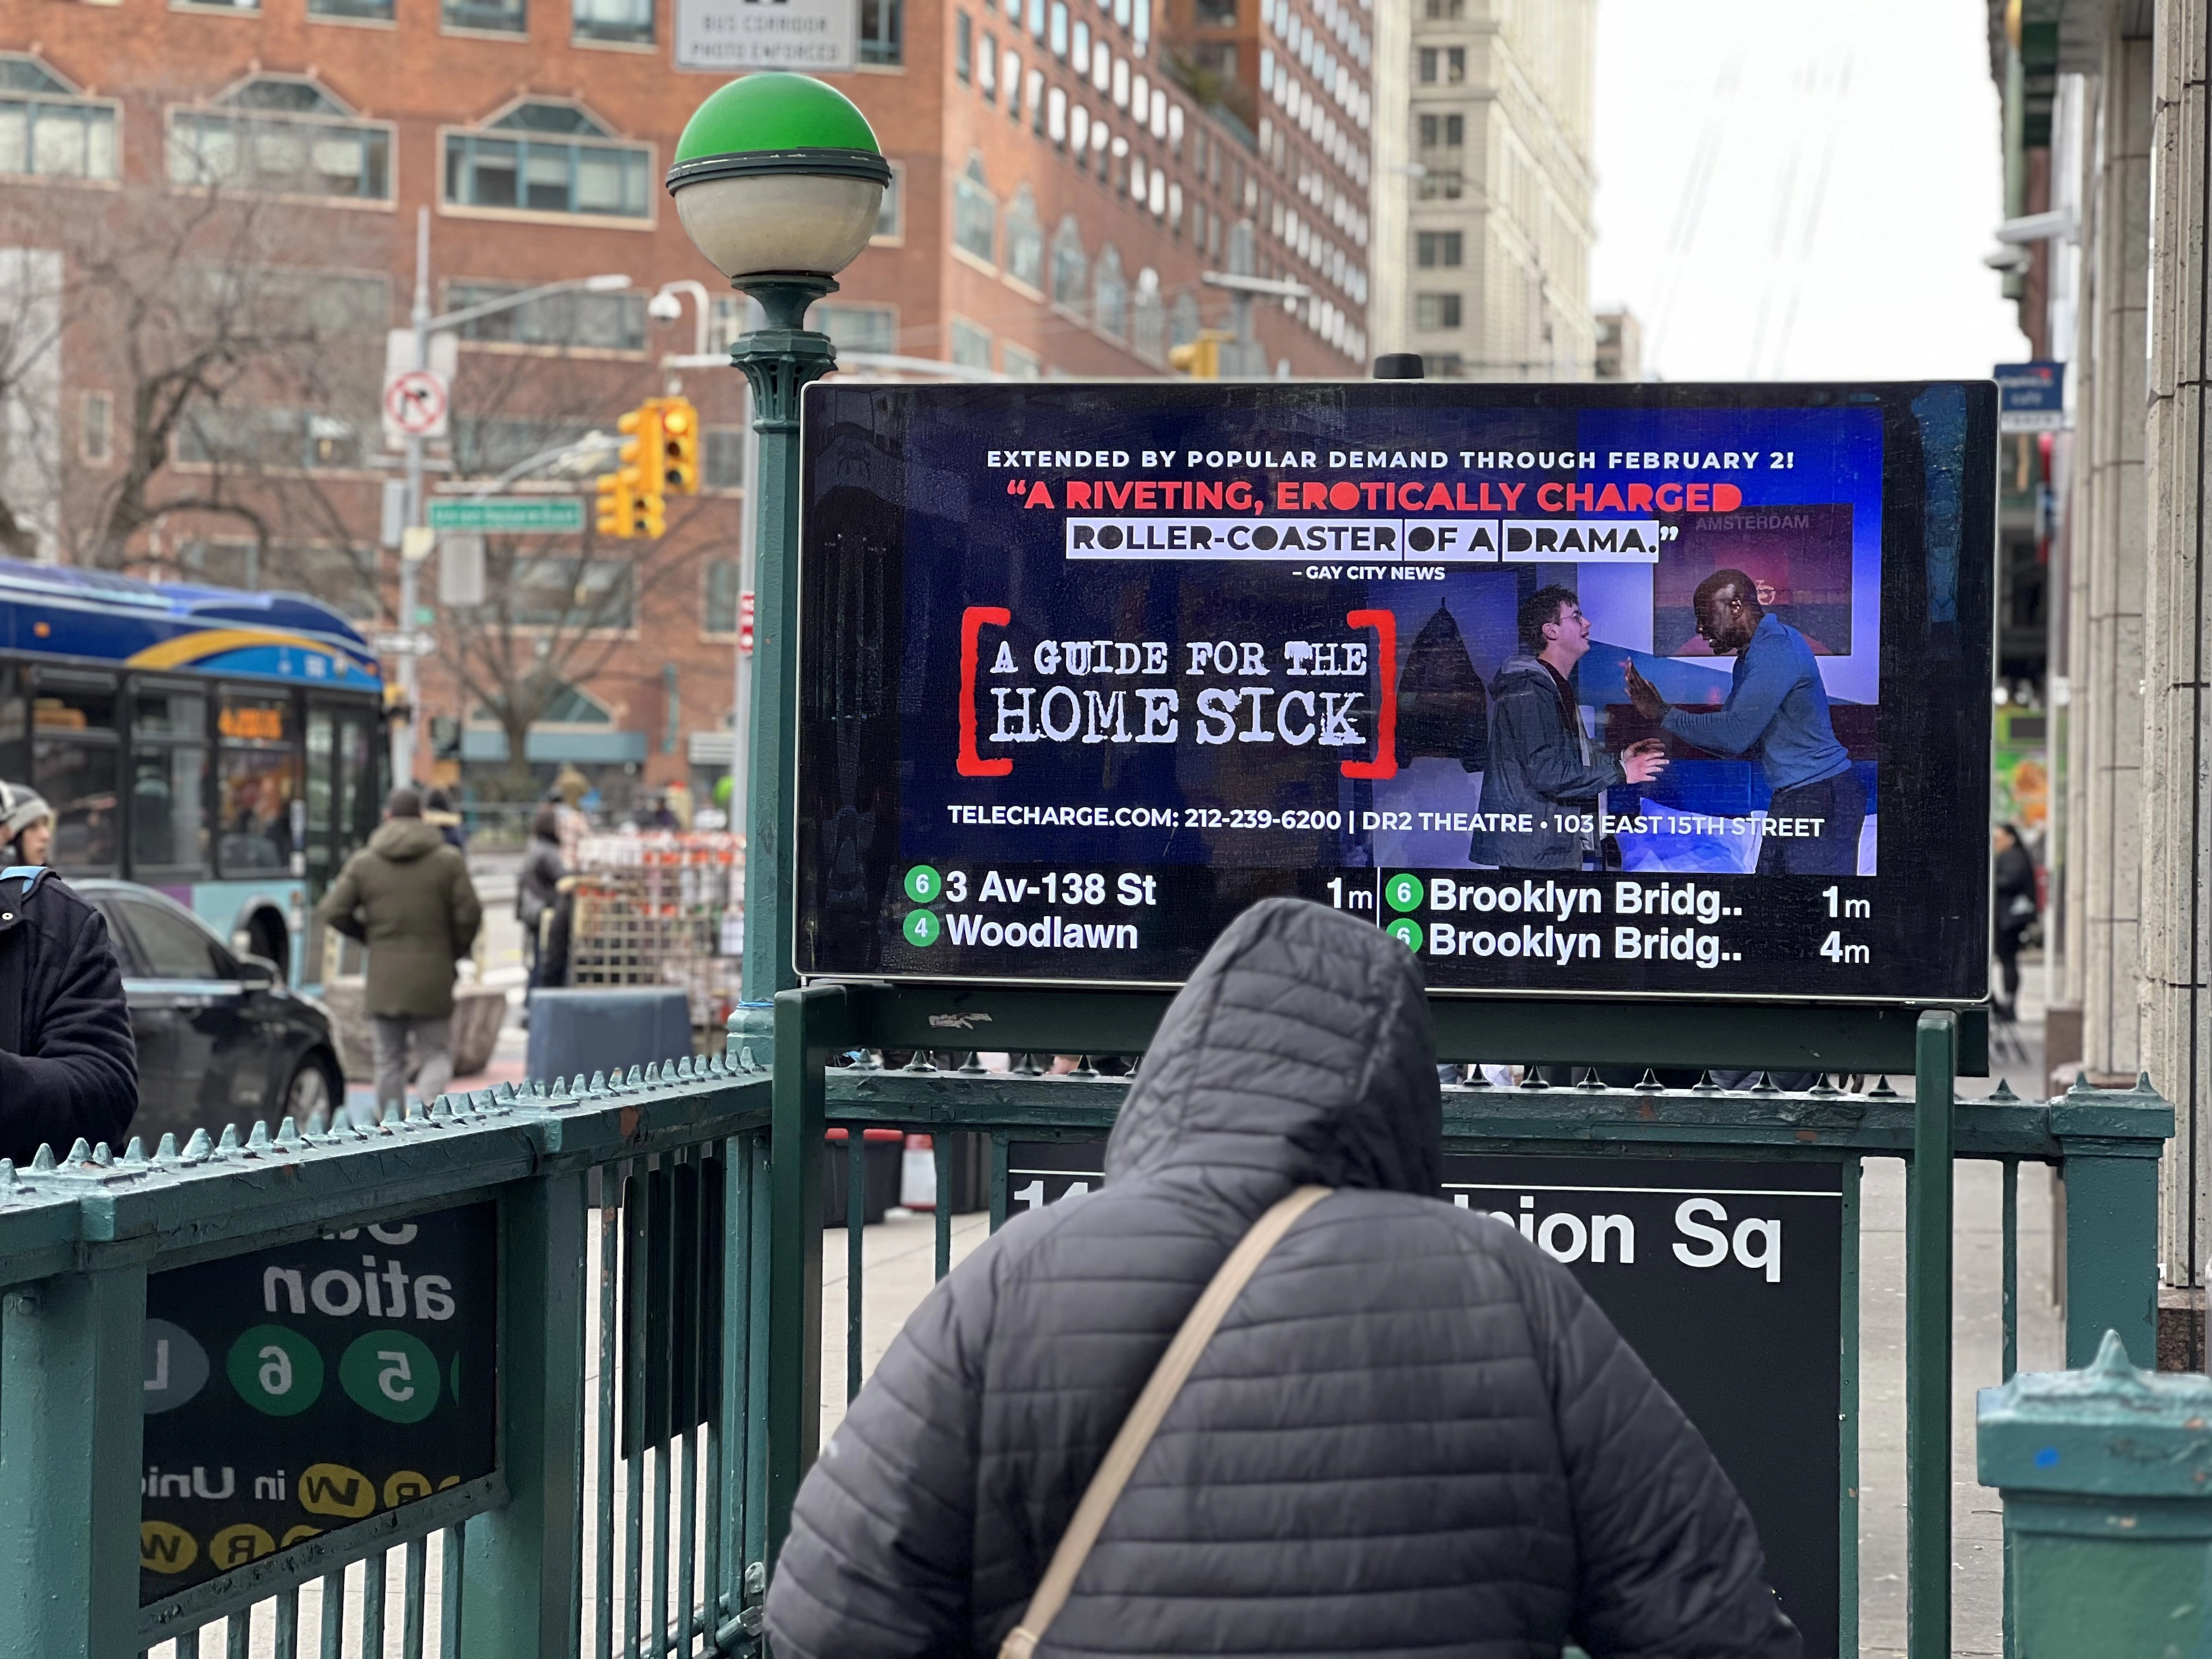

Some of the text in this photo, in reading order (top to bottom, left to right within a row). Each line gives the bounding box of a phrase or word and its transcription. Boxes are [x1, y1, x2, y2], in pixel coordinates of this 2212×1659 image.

[702, 14, 734, 33] BUS
[988, 451, 1793, 469] EXTENDED BY POPULAR DEMAND THROUGH FEBRUARY 2!
[1007, 479, 1741, 514] “A RIVETING, EROTICALLY CHARGED
[1073, 525, 1679, 553] ROLLER-COASTER OF A DRAMA.”
[1696, 515, 1809, 531] AMSTERDAM
[1347, 566, 1387, 579] CITY
[1391, 567, 1445, 580] NEWS
[990, 640, 1367, 675] A GUIDE FOR THE
[947, 806, 1824, 837] TELECHARGE.COM: 212-239-6200 DR2 THEATRE 103 EAST 15TH STREET
[916, 871, 1372, 909] 6 3 Av-138 St 1m
[1398, 878, 1870, 924] 6 Brooklyn Bridg.. 1m
[915, 914, 1137, 949] 4 Woodlawn
[1430, 923, 1601, 966] Brooklyn
[1615, 926, 1742, 968] Bridg..
[1820, 931, 1869, 963] 4m
[1672, 1198, 1781, 1282] Sq
